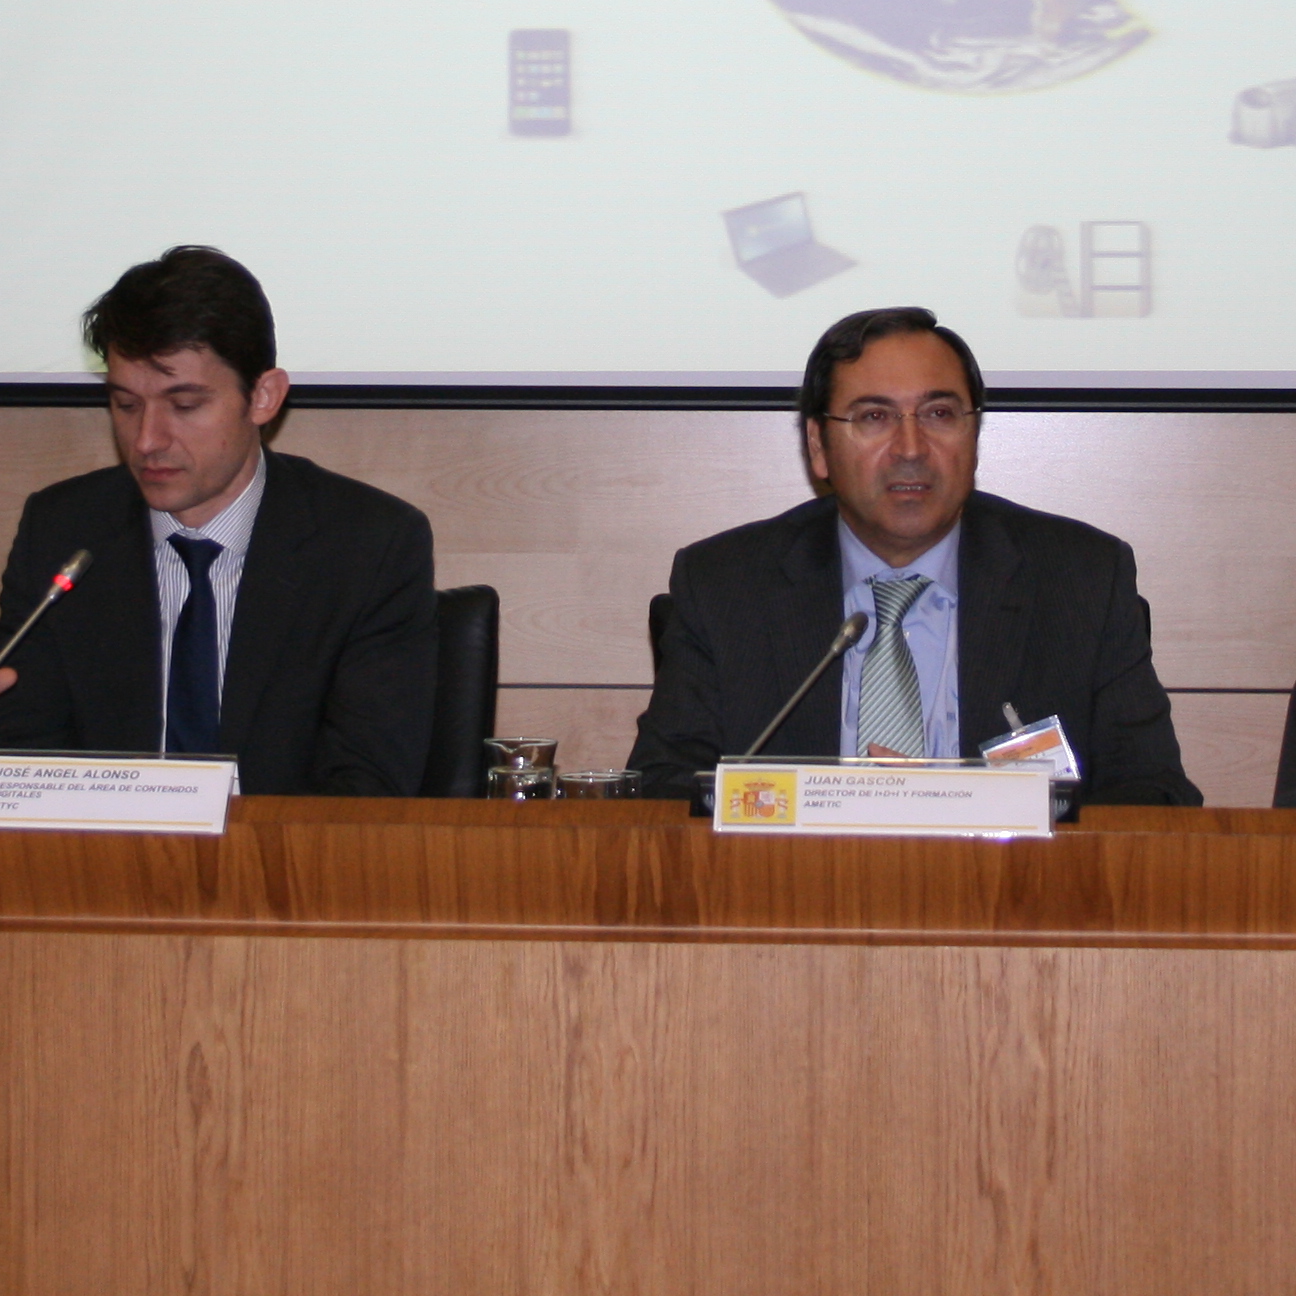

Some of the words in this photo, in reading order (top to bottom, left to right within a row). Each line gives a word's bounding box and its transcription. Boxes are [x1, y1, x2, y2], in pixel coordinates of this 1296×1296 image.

[34, 768, 78, 780] ANGEL
[83, 769, 140, 780] ALONSO
[804, 775, 842, 786] JUAN
[846, 775, 906, 786] GASCÓN
[68, 783, 85, 792] DEL
[119, 783, 133, 792] DE
[134, 784, 198, 794] CONTENIDOS
[804, 789, 857, 798] DIRECTOR
[858, 789, 872, 798] DE
